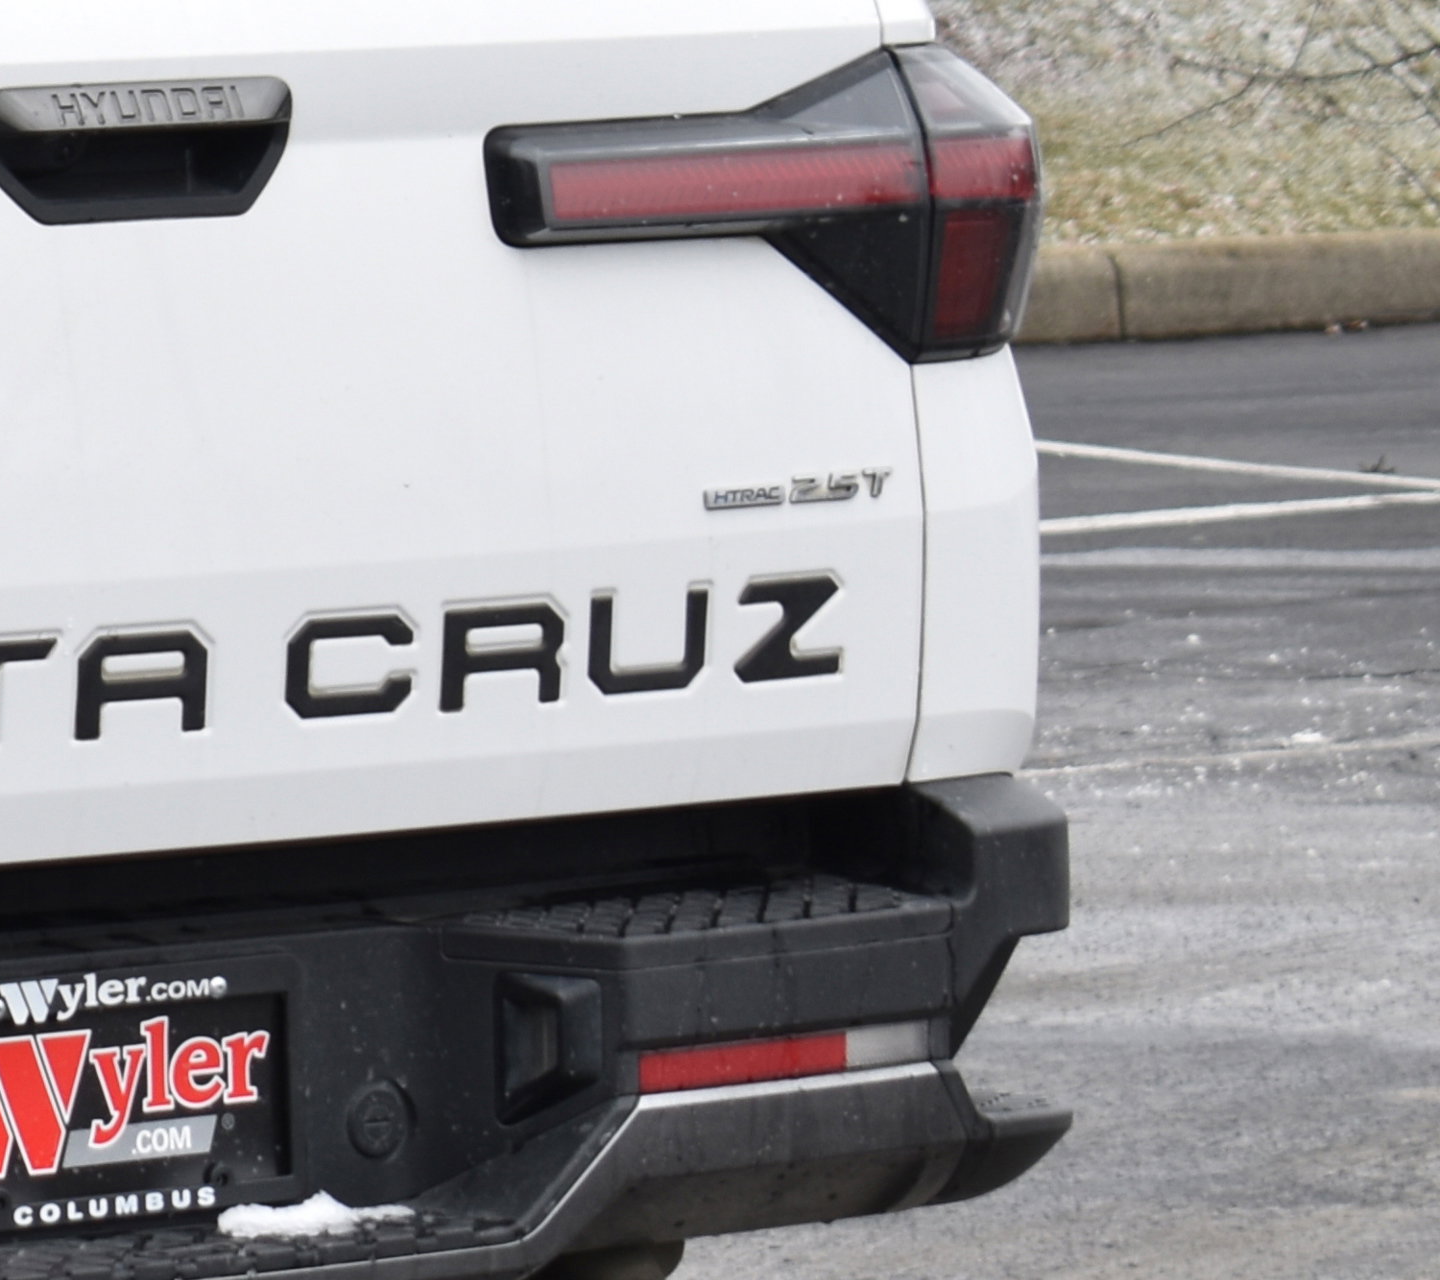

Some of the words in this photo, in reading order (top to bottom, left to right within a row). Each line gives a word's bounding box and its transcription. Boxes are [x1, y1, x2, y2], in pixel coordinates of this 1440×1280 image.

[52, 86, 244, 125] HYUNDAI
[713, 486, 781, 504] HTRAC
[284, 574, 842, 719] CRUZ
[13, 1186, 217, 1226] COLUMBUS
